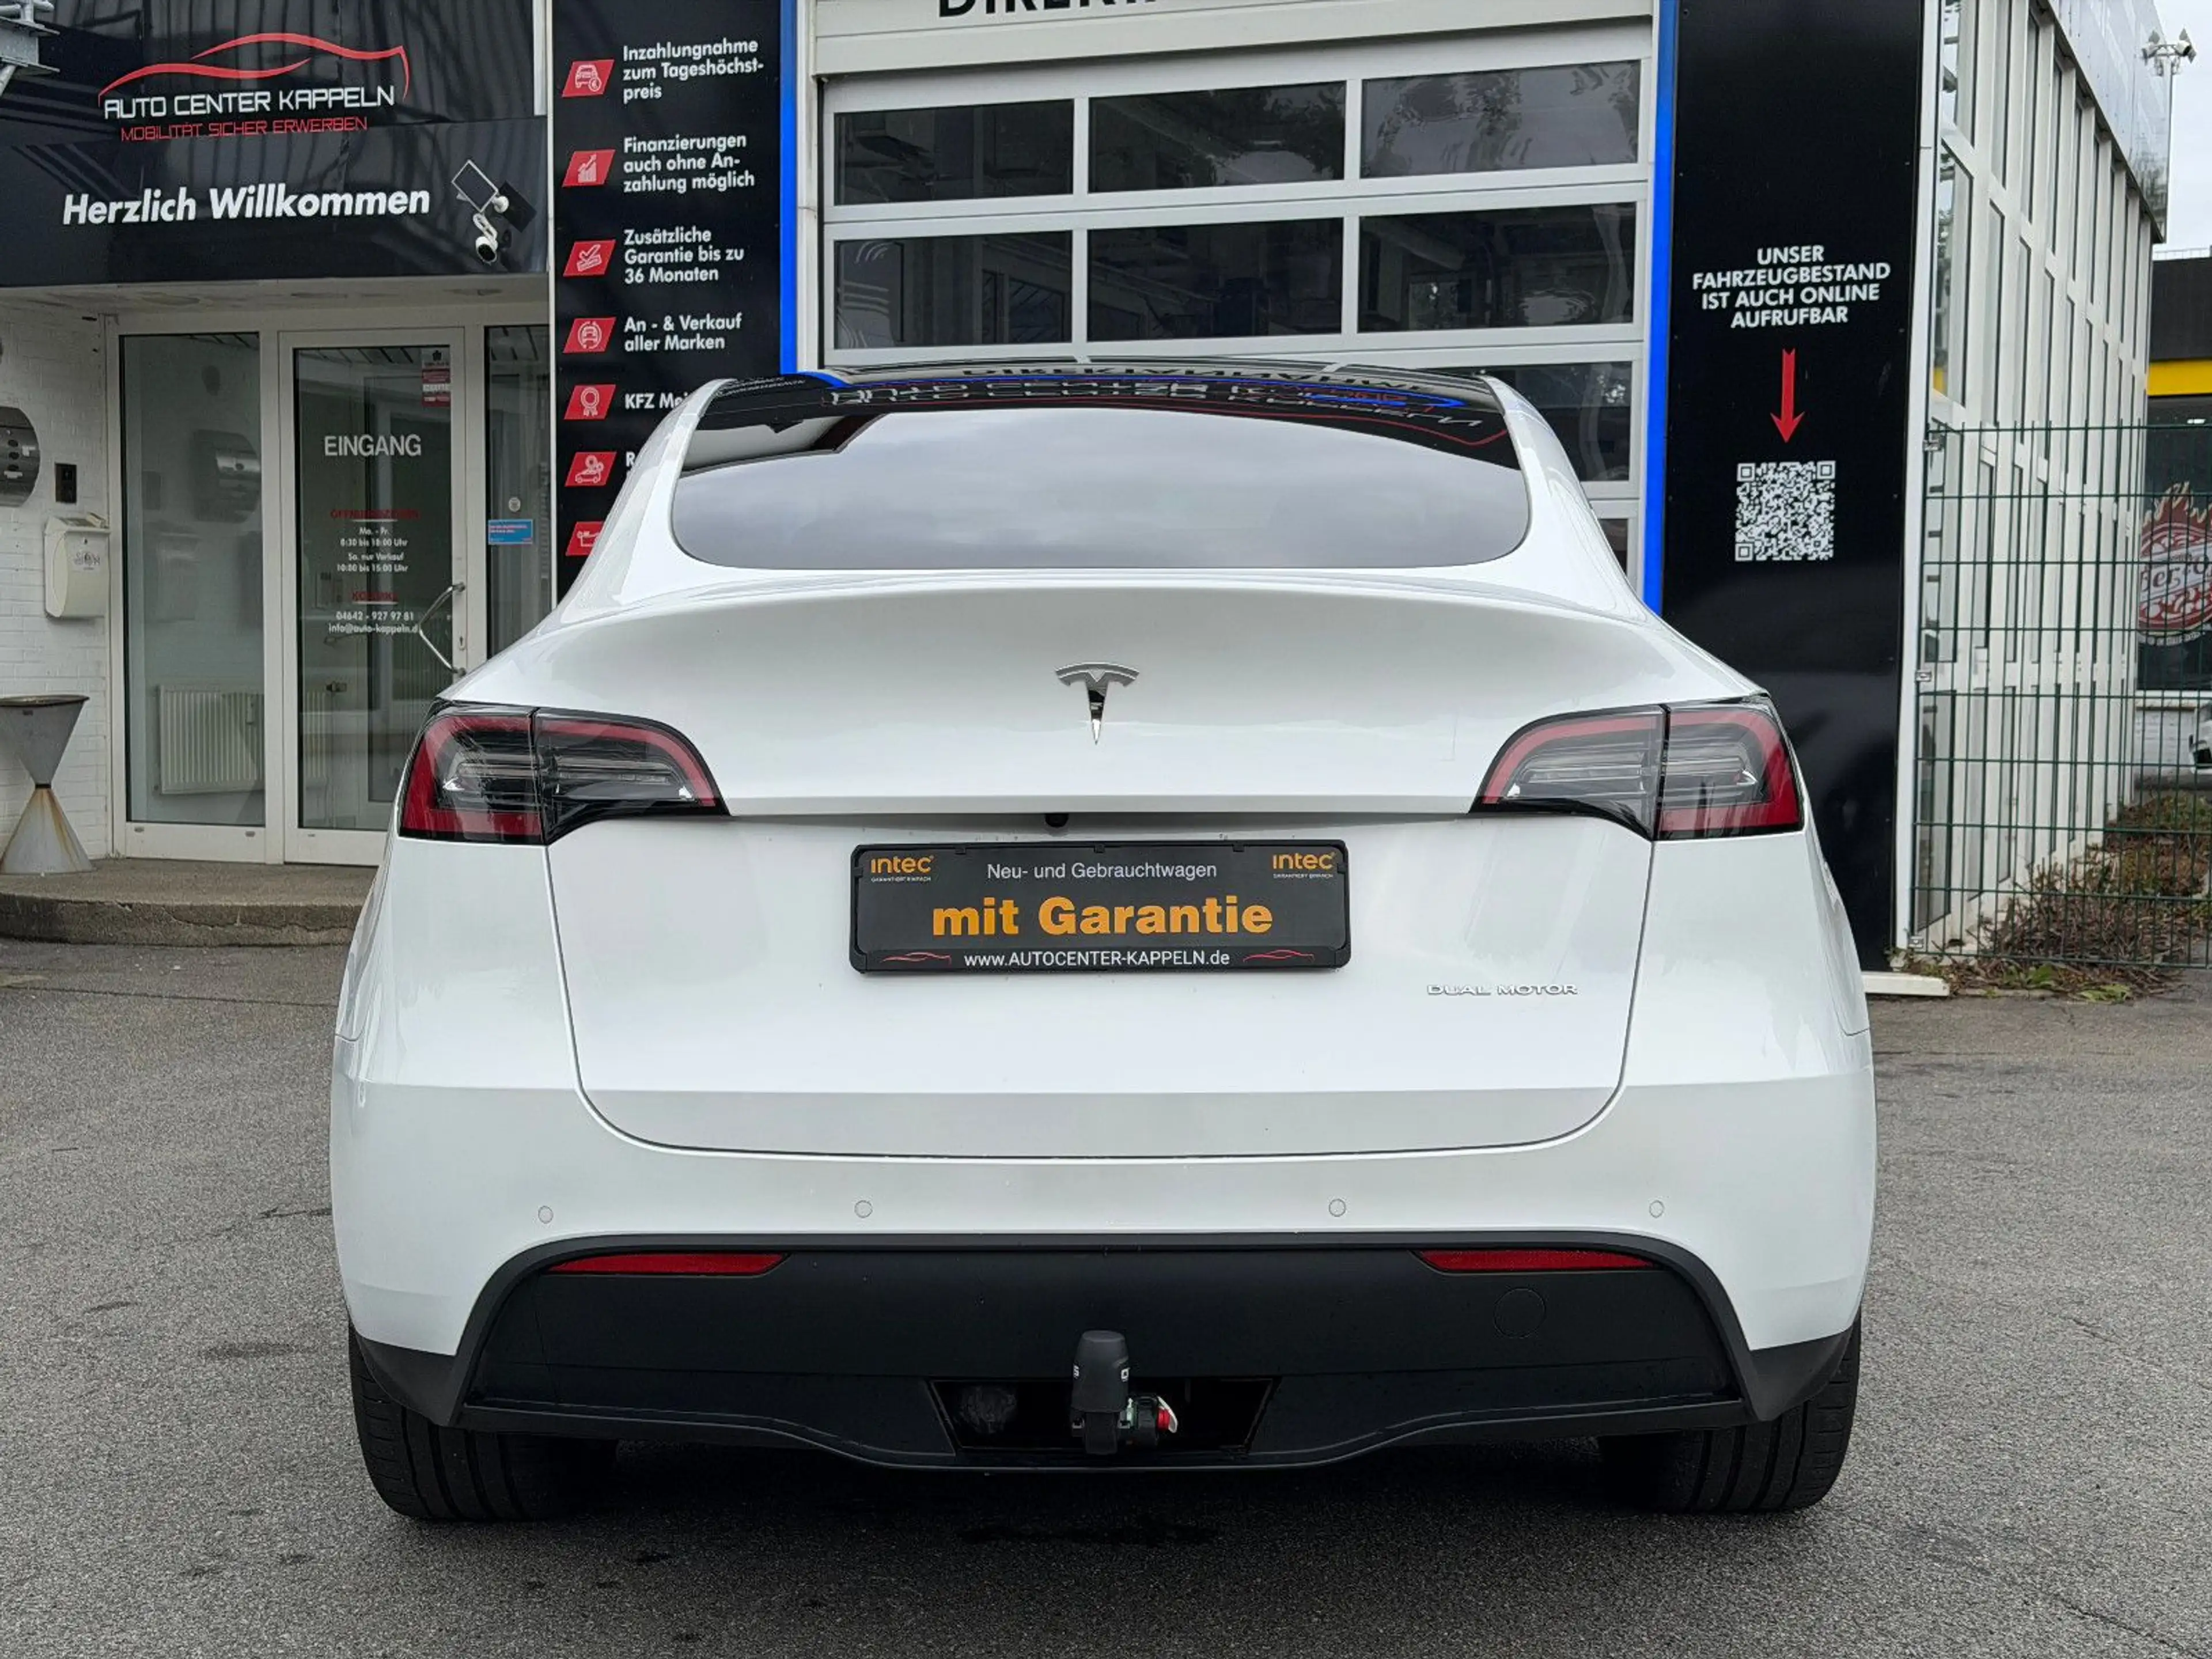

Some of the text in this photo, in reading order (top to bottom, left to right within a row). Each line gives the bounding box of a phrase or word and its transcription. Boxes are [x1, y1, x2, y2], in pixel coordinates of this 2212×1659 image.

[623, 38, 758, 61] Inzahlungnahme
[623, 57, 764, 81] zum Tageshöchst-
[104, 85, 395, 119] AUTO CENTER KAPPELN
[623, 83, 662, 104] preis
[208, 119, 267, 137] SICHER
[273, 116, 368, 134] ERWERBEN
[623, 134, 747, 153] Finanzierungen
[624, 153, 740, 172] auch ohne An-
[624, 171, 755, 193] zahlung möglich
[62, 182, 430, 225] Herzlich Willkommen
[624, 226, 711, 245] Zusätzliche
[624, 245, 744, 264] Garantie bis zu
[1757, 244, 1824, 265] UNSER
[624, 267, 719, 284] 36 Monaten
[1693, 262, 1891, 289] FAHRZEUGBESTAND
[1702, 283, 1880, 309] IST AUCH ONLINE
[624, 317, 646, 332] An
[663, 316, 674, 331] &
[679, 312, 742, 331] Verkauf
[1730, 306, 1848, 328] AUFRUFBAR
[624, 334, 725, 352] aller Marken
[625, 393, 655, 410] KFZ
[324, 434, 422, 456] EINGANG
[987, 862, 1217, 881] Neu- und Gebrauchtwagen
[933, 895, 1273, 936] mit Garantie
[964, 950, 1230, 967] www.AUTOCENTER-KAPPELN.de
[1427, 983, 1578, 997] DUAL MOTOR
